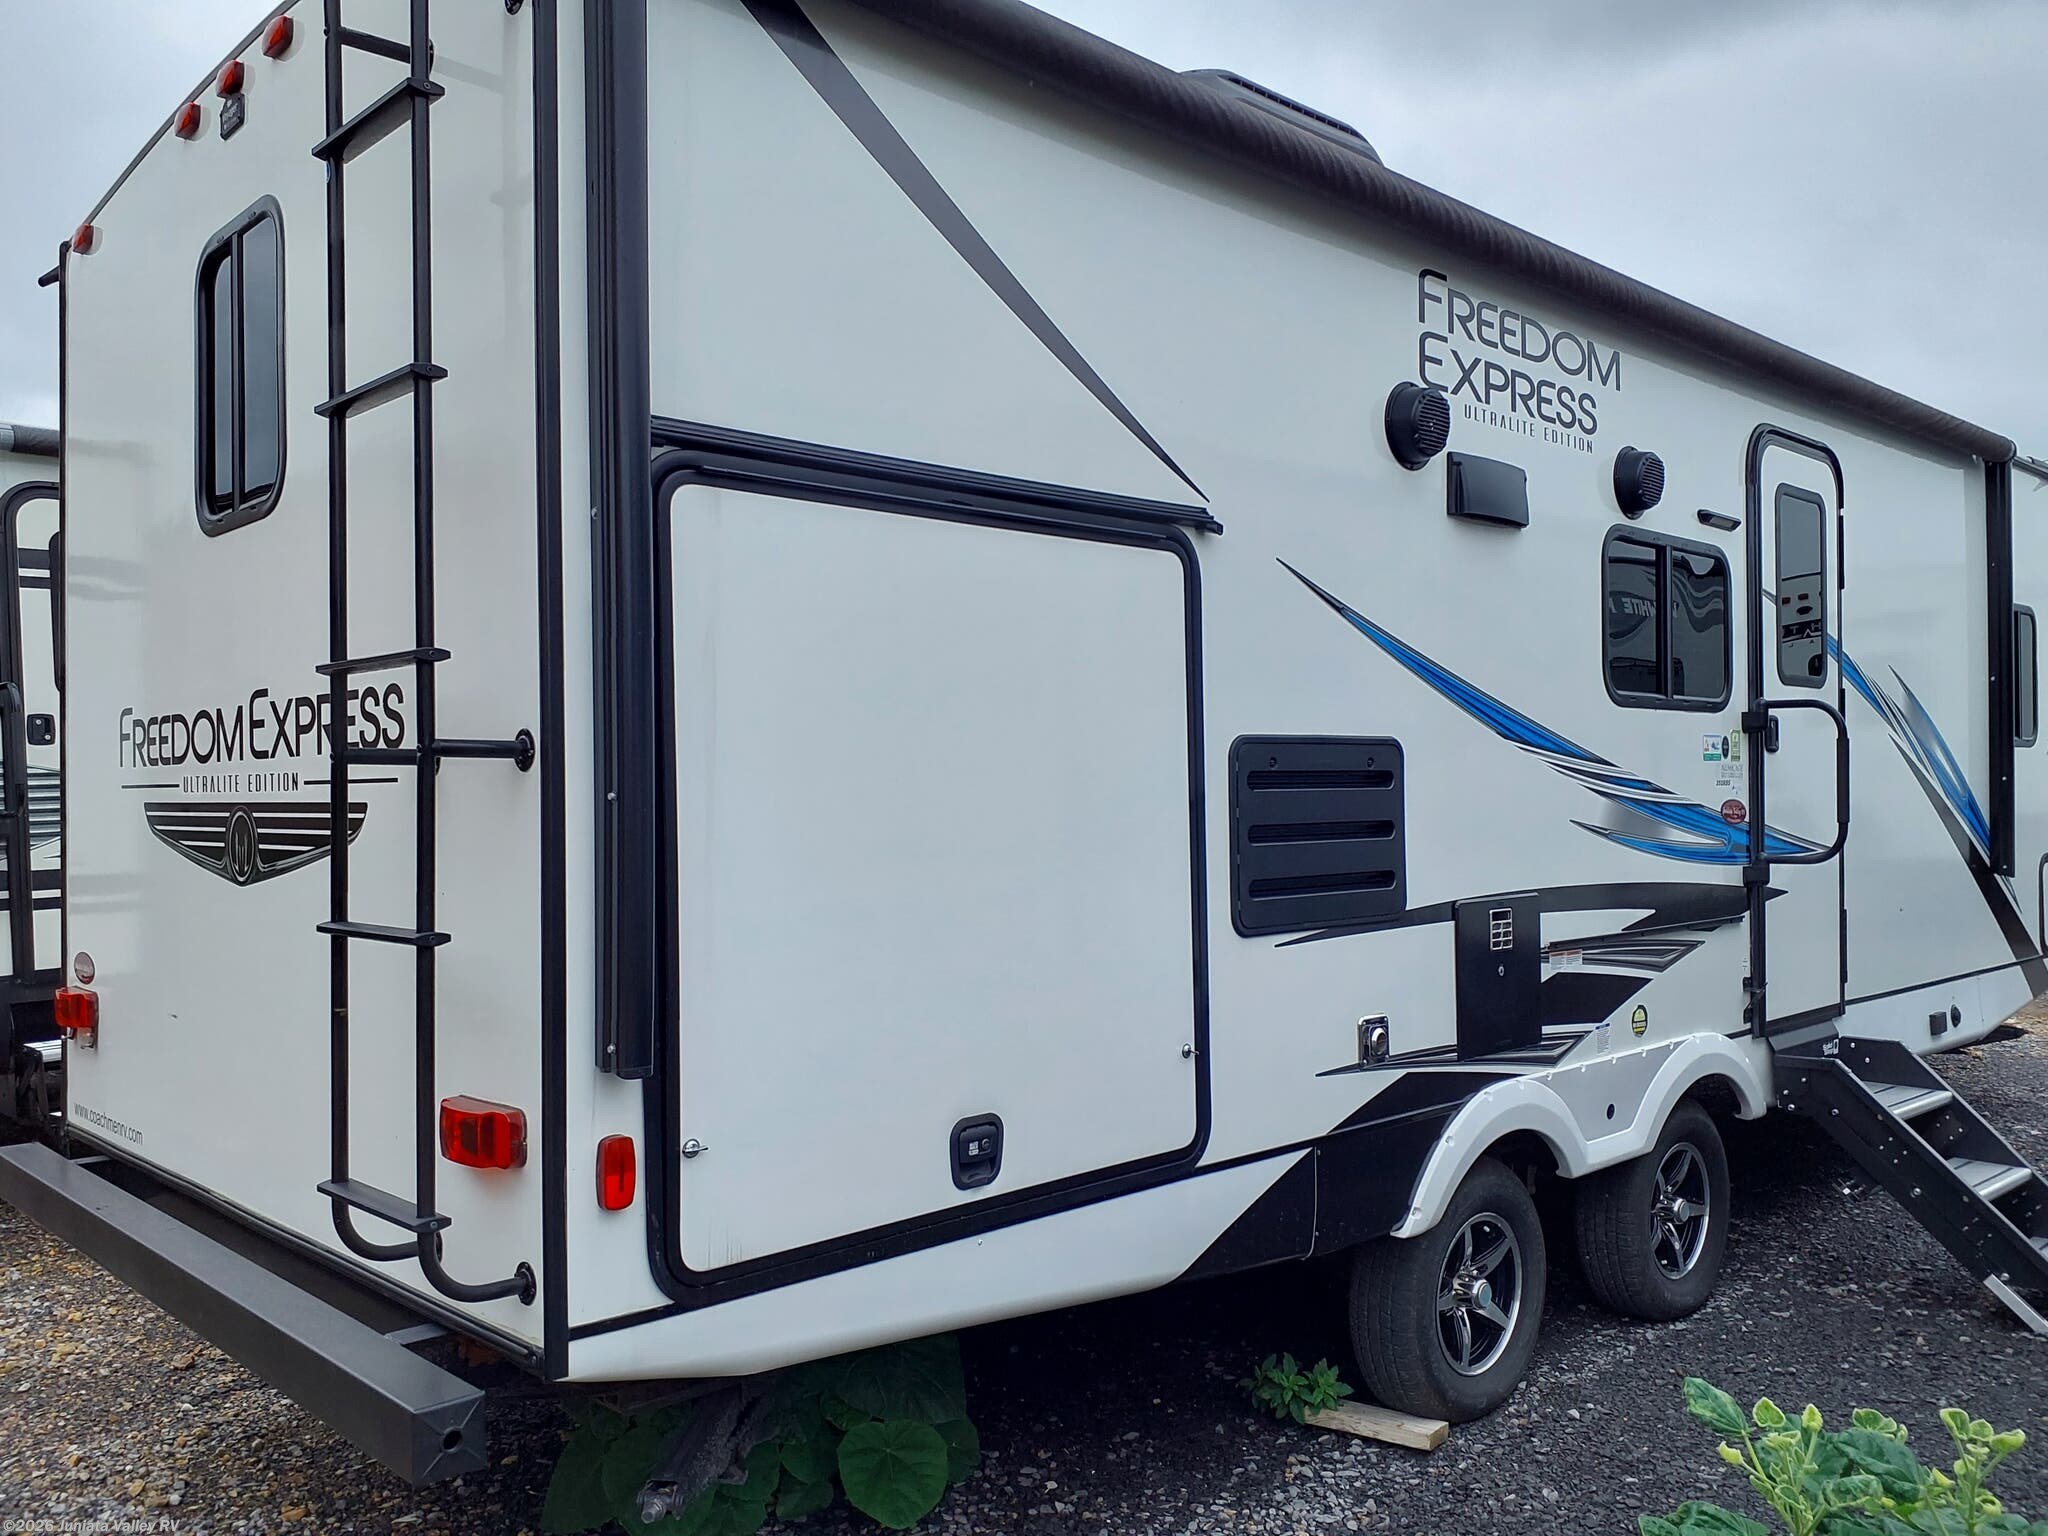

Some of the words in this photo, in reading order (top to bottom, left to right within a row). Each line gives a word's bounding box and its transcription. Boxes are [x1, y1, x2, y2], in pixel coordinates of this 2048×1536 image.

[1418, 268, 1621, 391] FREEDOM
[1419, 331, 1598, 435] EXPRESS
[1464, 403, 1536, 438] ULTRALITE
[1544, 427, 1593, 454] EDITION
[119, 705, 244, 768] FREEDOM
[182, 774, 240, 794] ULTRALITE
[248, 772, 299, 792] EDITION
[74, 1103, 143, 1145] www.coachmenrv.com
